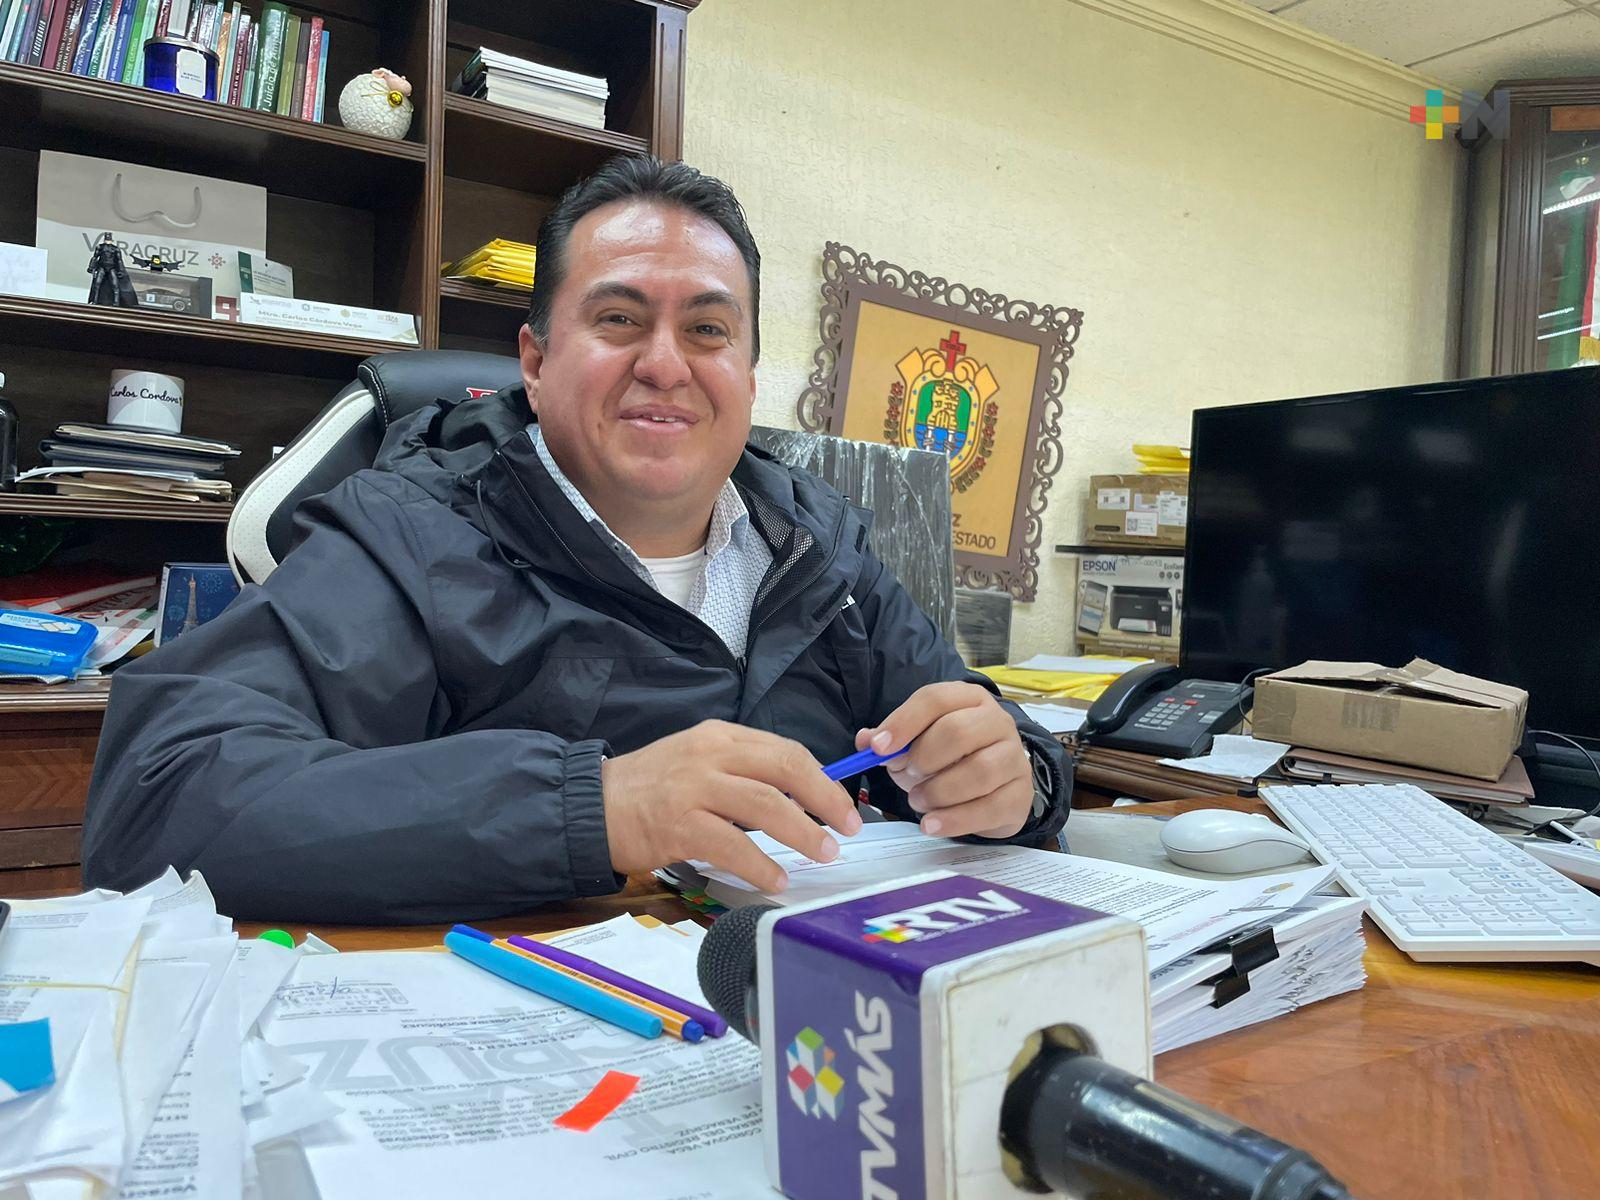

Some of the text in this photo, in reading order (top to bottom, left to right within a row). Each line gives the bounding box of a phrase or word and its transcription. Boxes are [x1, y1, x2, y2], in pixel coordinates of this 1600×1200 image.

[263, 77, 276, 107] Juicio
[82, 232, 199, 266] VRACRUZ
[1082, 560, 1116, 571] EPSON
[863, 889, 1023, 938] RTV
